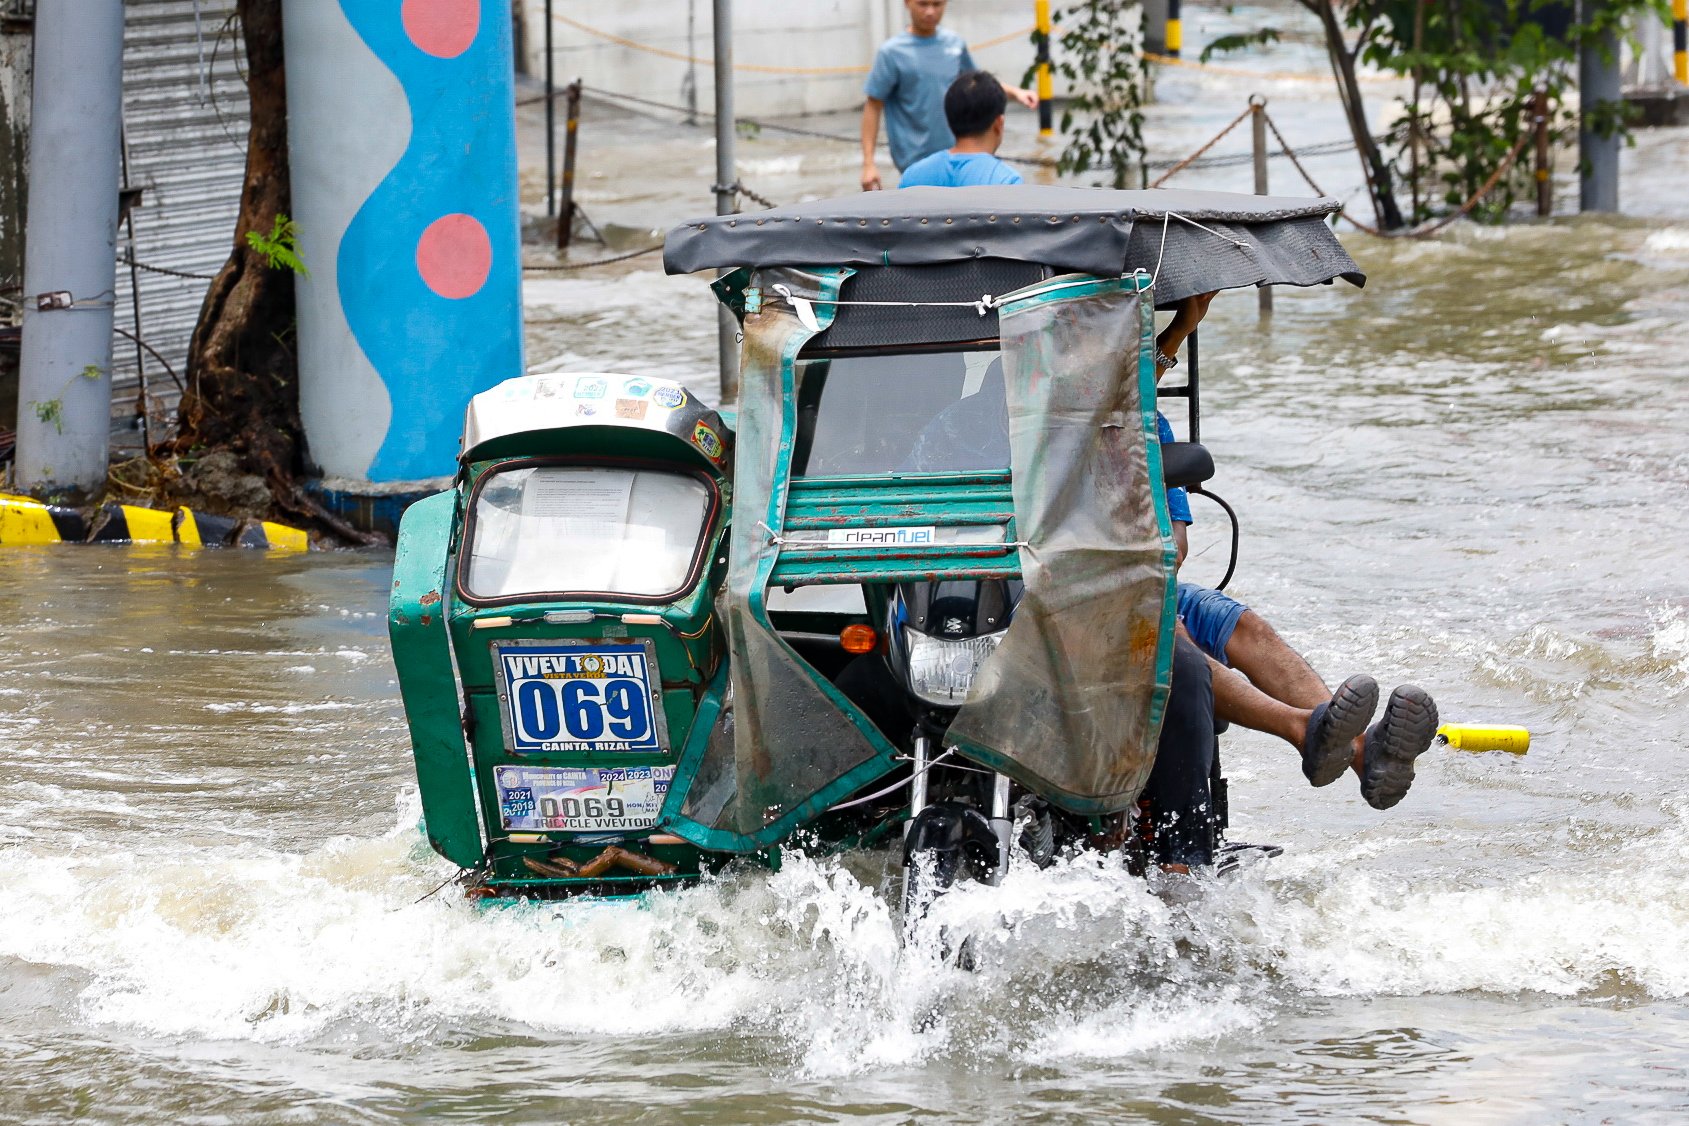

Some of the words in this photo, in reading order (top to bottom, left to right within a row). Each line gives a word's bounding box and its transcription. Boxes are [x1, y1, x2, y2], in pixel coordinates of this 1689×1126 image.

[846, 530, 931, 544] cleanfuel
[507, 656, 567, 680] VVEV
[518, 679, 649, 741] 069
[595, 742, 632, 751] RIZAL
[600, 772, 625, 781] 2024
[628, 770, 651, 779] 2023
[509, 791, 531, 800] 2021
[512, 801, 534, 811] 2018
[540, 797, 625, 819] 0069
[534, 818, 592, 829] TRICYCLE
